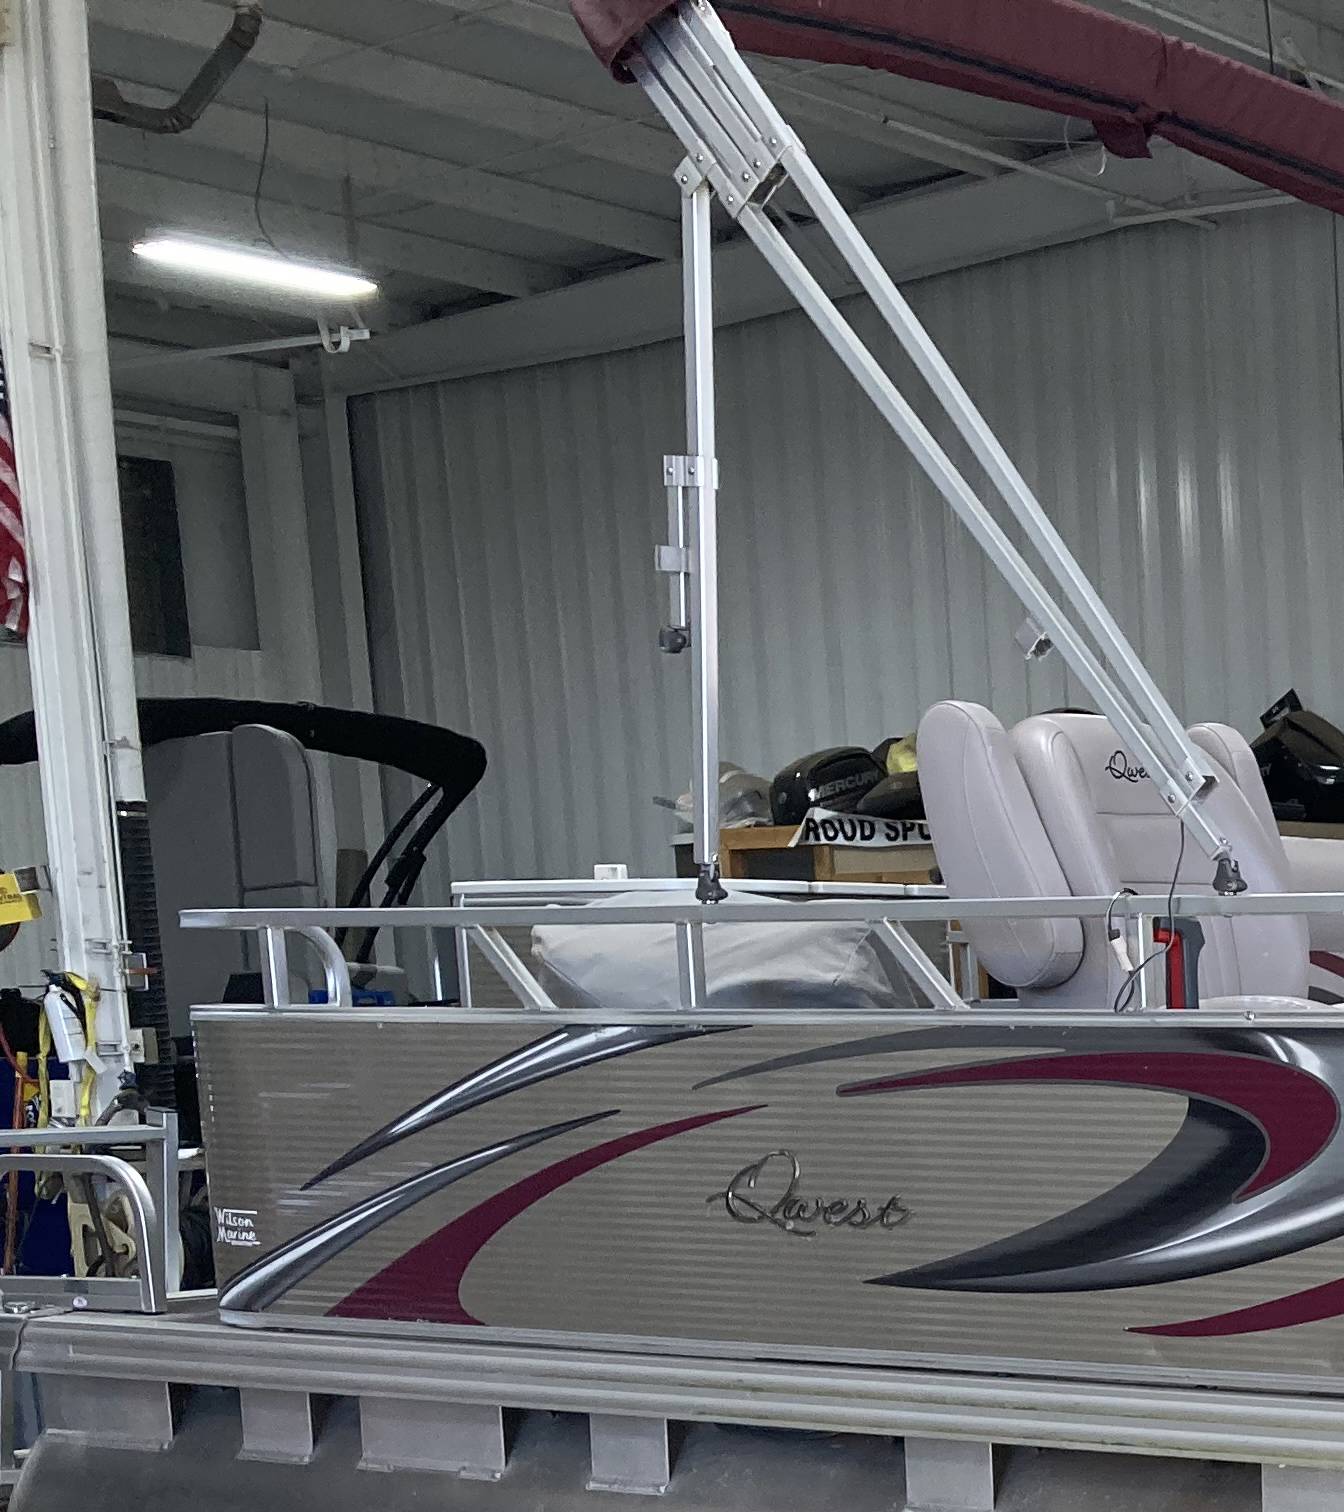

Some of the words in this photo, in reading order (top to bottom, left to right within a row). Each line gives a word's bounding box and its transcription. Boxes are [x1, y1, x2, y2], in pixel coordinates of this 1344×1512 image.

[705, 1149, 916, 1237] Qwest
[213, 1206, 256, 1228] Wilson
[216, 1225, 257, 1243] Marine
